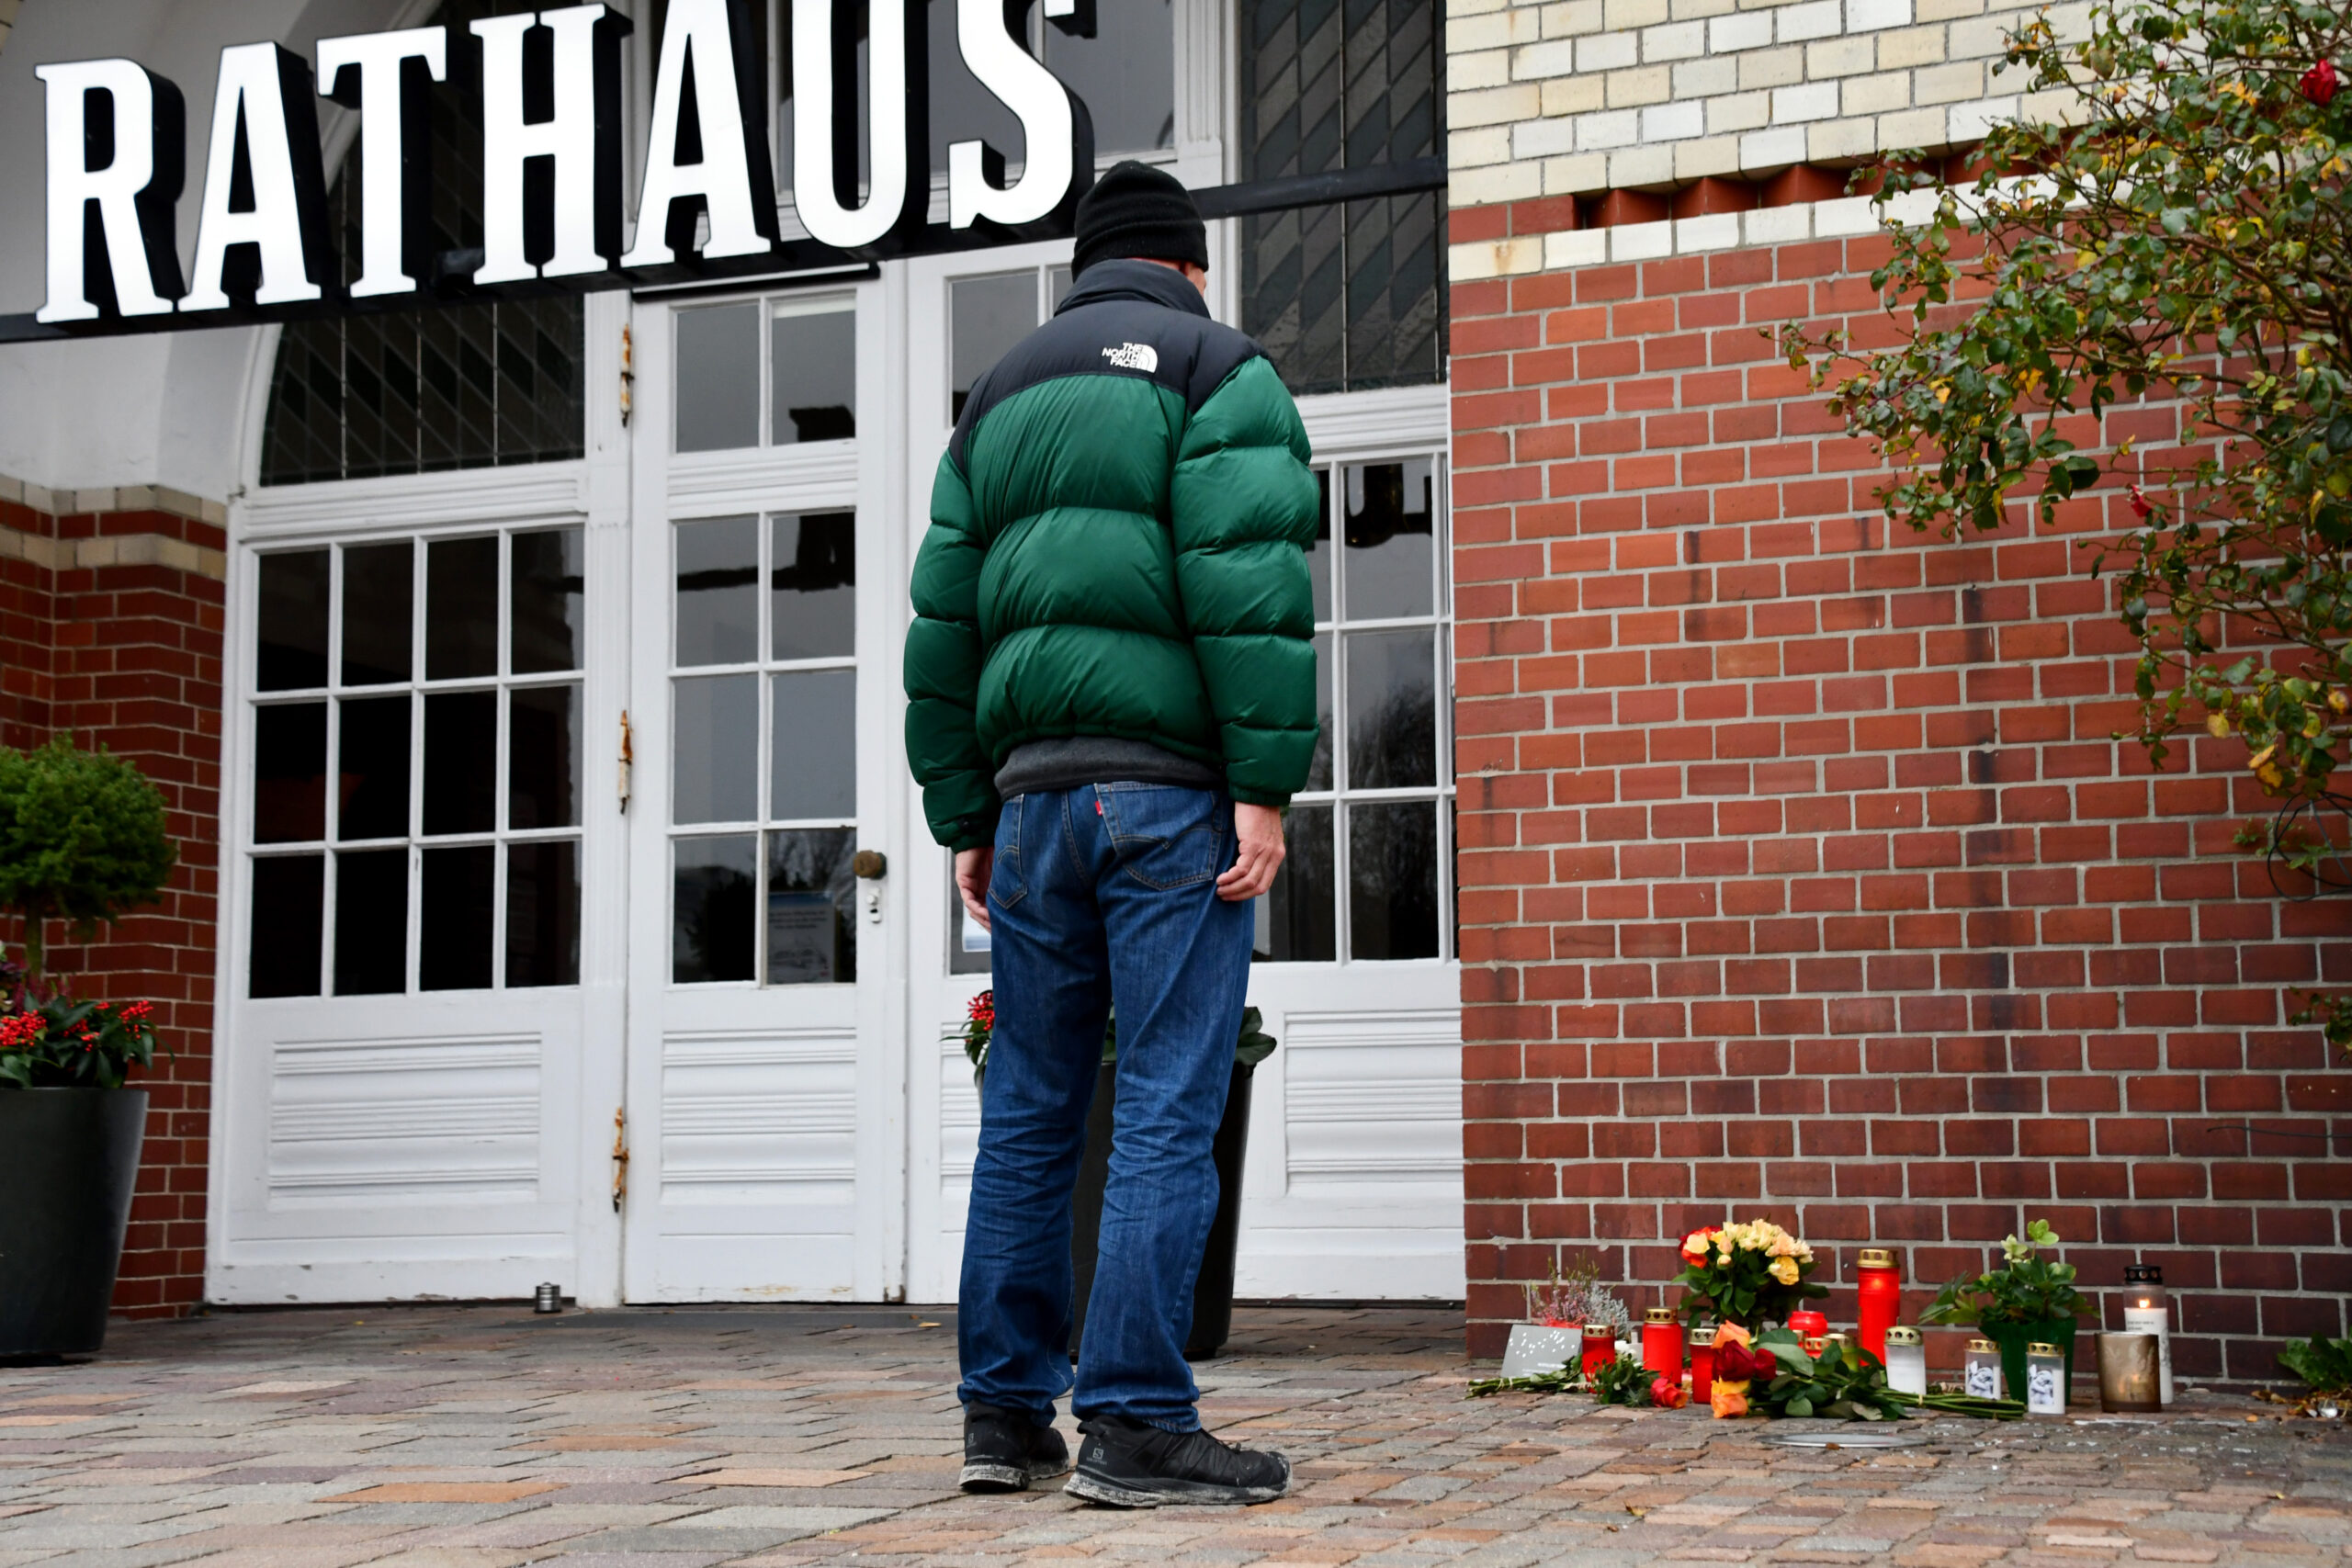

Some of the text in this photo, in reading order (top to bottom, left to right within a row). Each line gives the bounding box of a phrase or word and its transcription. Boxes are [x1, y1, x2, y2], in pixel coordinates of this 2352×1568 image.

[35, 0, 1073, 323] RATHAUS
[1102, 347, 1139, 361] NORTH
[1123, 342, 1143, 353] THE
[1110, 355, 1136, 368] FACE
